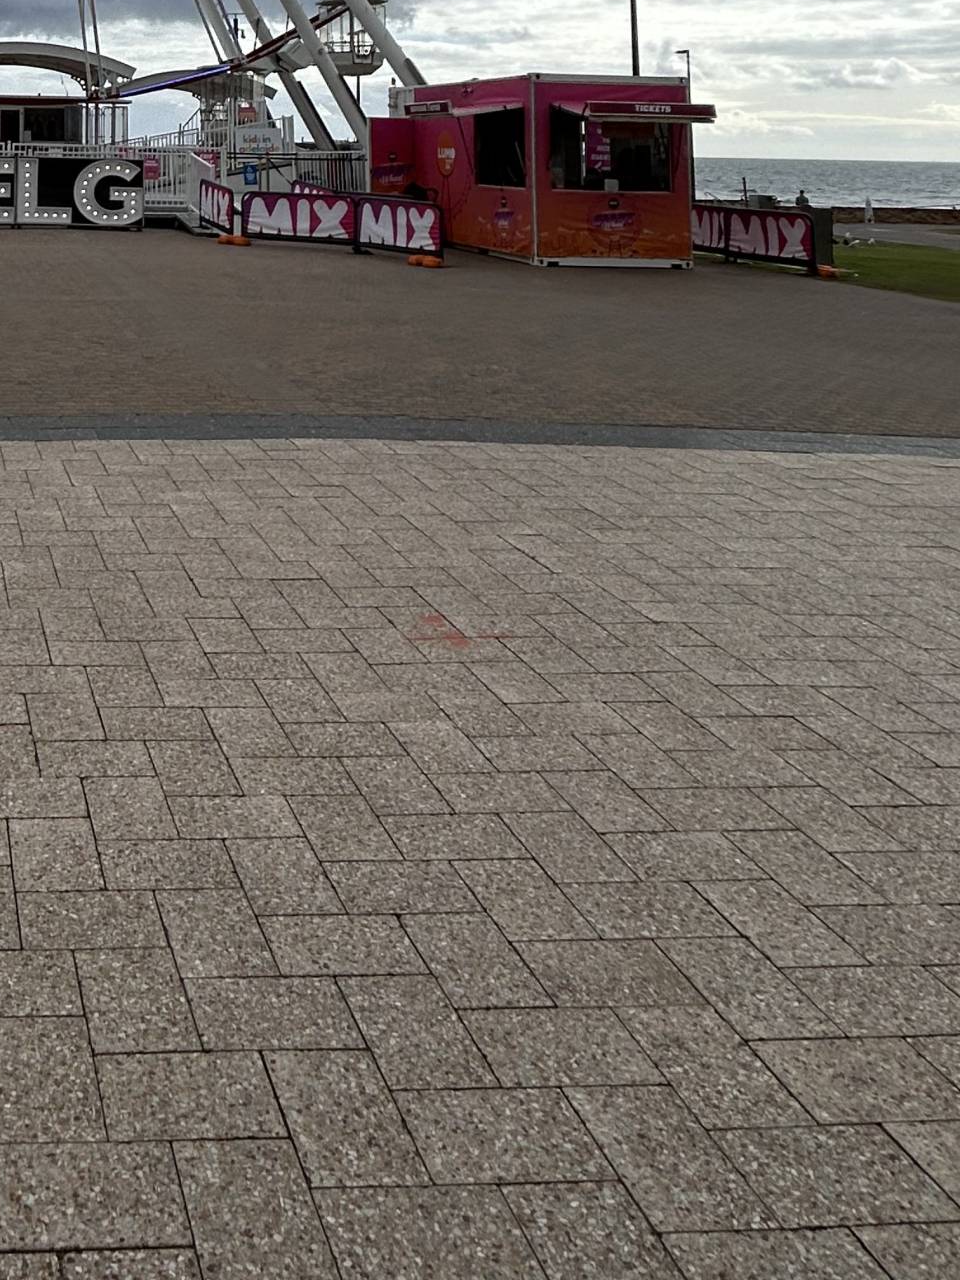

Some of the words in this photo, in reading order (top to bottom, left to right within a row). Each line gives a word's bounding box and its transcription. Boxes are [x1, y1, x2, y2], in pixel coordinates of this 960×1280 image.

[634, 104, 672, 113] TICKETS
[200, 184, 230, 229] MIX
[247, 196, 349, 239] MIX
[360, 202, 436, 251] MIX
[729, 213, 809, 260] MIX
